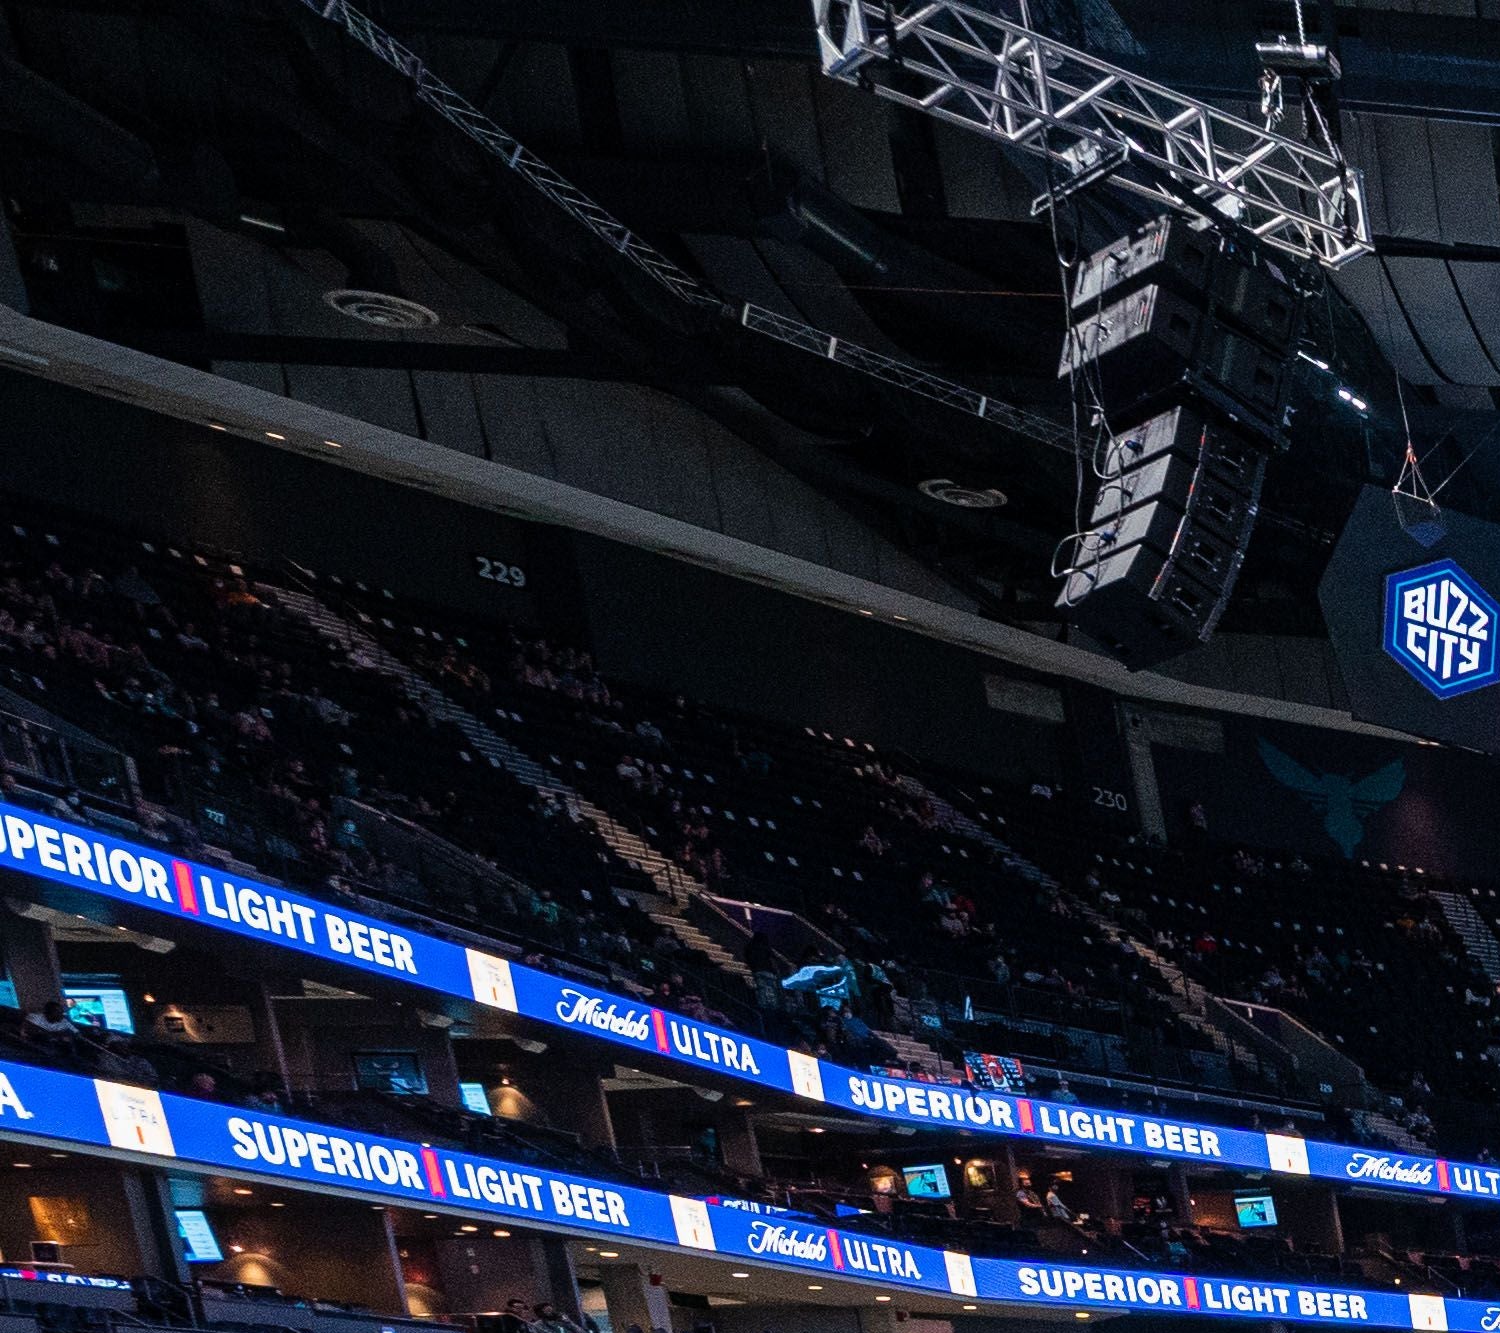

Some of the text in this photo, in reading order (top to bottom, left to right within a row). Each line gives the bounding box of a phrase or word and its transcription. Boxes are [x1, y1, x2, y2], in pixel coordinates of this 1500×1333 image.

[476, 556, 526, 587] 229
[1404, 580, 1489, 641] BUZZ
[1406, 622, 1480, 679] CITY
[1093, 786, 1128, 812] 230
[201, 876, 417, 974] LIGHT BEER
[556, 989, 760, 1077] Michelob ULTRA
[849, 1074, 1221, 1156] SUPERIOR LIGHT BEER
[230, 1116, 629, 1226] SUPERIOR LIGHT BEER
[1346, 1153, 1433, 1184] Michelob
[748, 1221, 921, 1280] Michelob ULTRA
[1018, 1268, 1367, 1319] SUPERIOR LIGHT BEER
